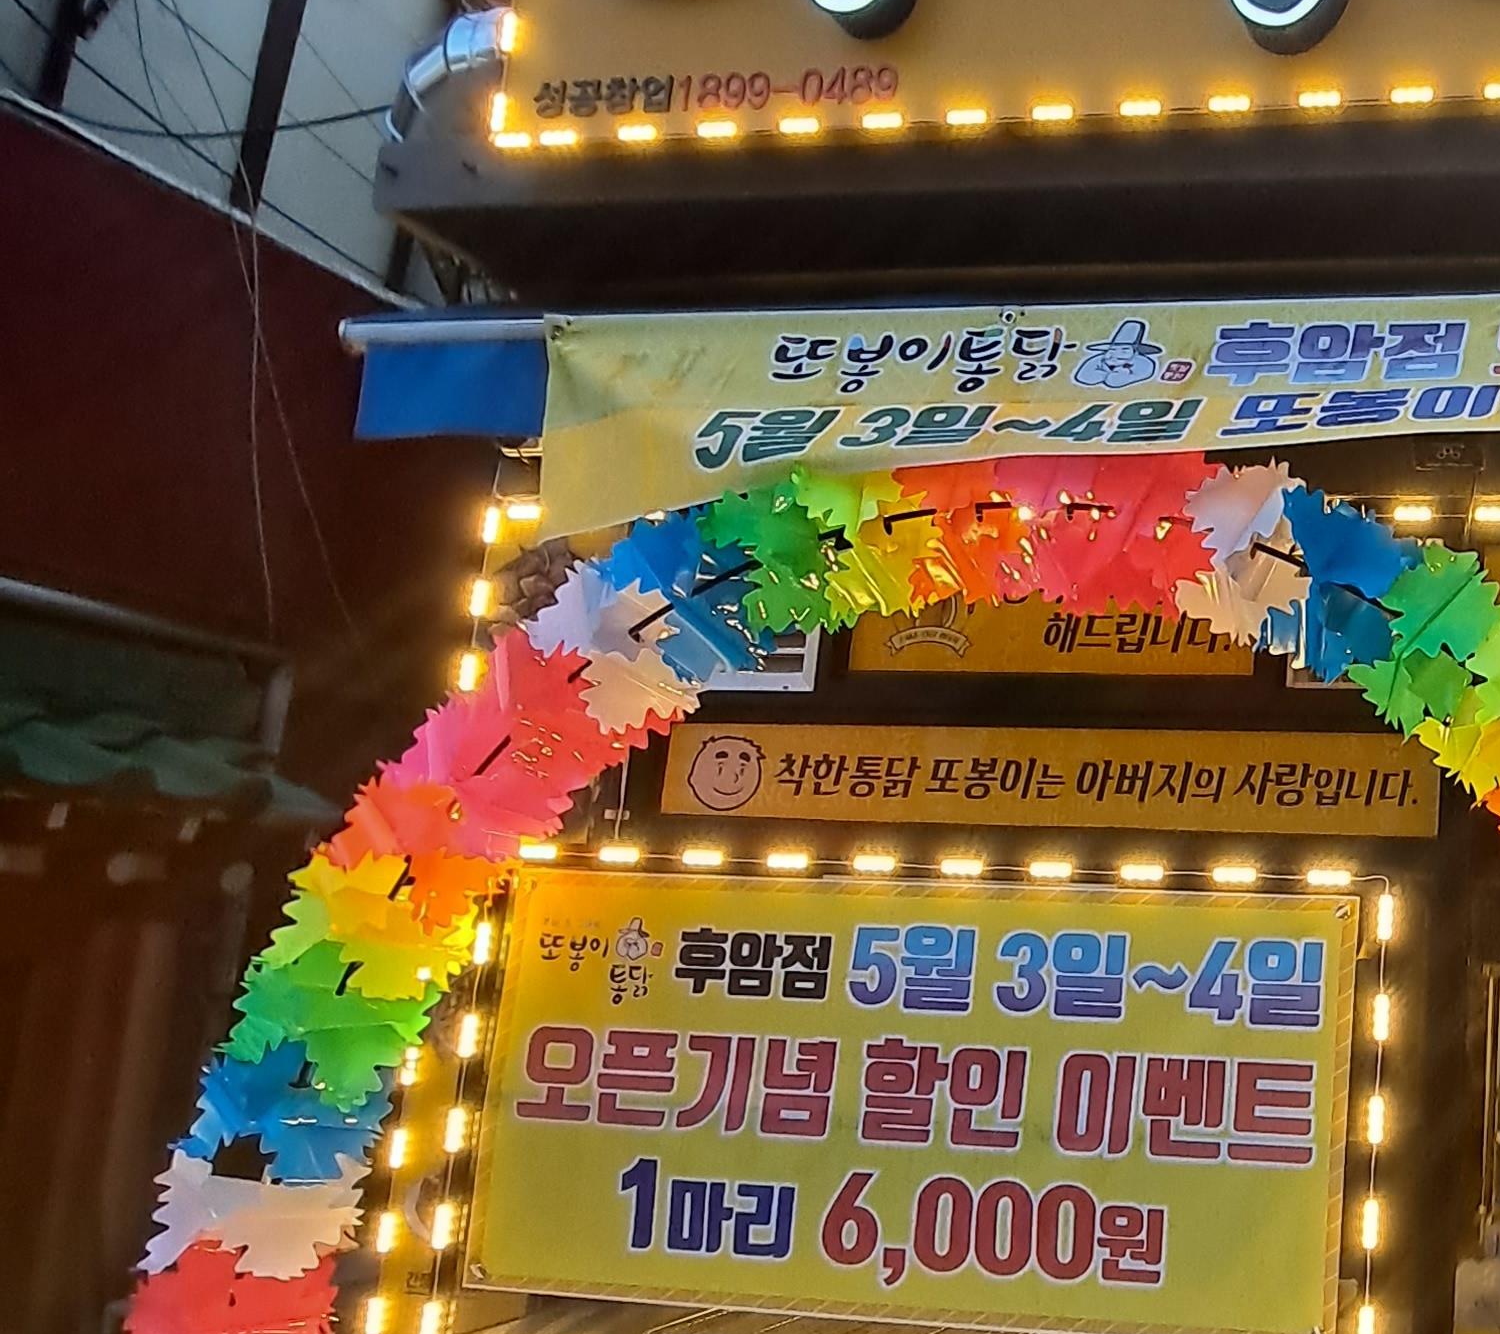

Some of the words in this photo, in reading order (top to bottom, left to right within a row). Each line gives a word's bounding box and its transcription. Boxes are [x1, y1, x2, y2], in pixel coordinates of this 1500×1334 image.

[772, 326, 1075, 394] 또봉이통닭
[1207, 319, 1466, 386] 후암점
[694, 406, 841, 472] 5월
[837, 395, 1205, 451] 3일~4일
[774, 753, 921, 800] 착한통닭
[925, 757, 1066, 802] 또봉이는
[1075, 759, 1223, 805] 아버지의
[1232, 761, 1419, 809] 사랑입니다.
[539, 931, 609, 972] 또봉이
[674, 926, 832, 1000] 후암점
[849, 924, 975, 1015] 5월
[996, 932, 1324, 1030] 3일~4일
[609, 964, 654, 1005] 통닭
[515, 1026, 836, 1139] 오픈기념
[860, 1035, 1029, 1150] 할인
[1055, 1052, 1316, 1165] 이벤트
[620, 1158, 795, 1259] 1마리
[821, 1172, 1168, 1287] 6,000원
